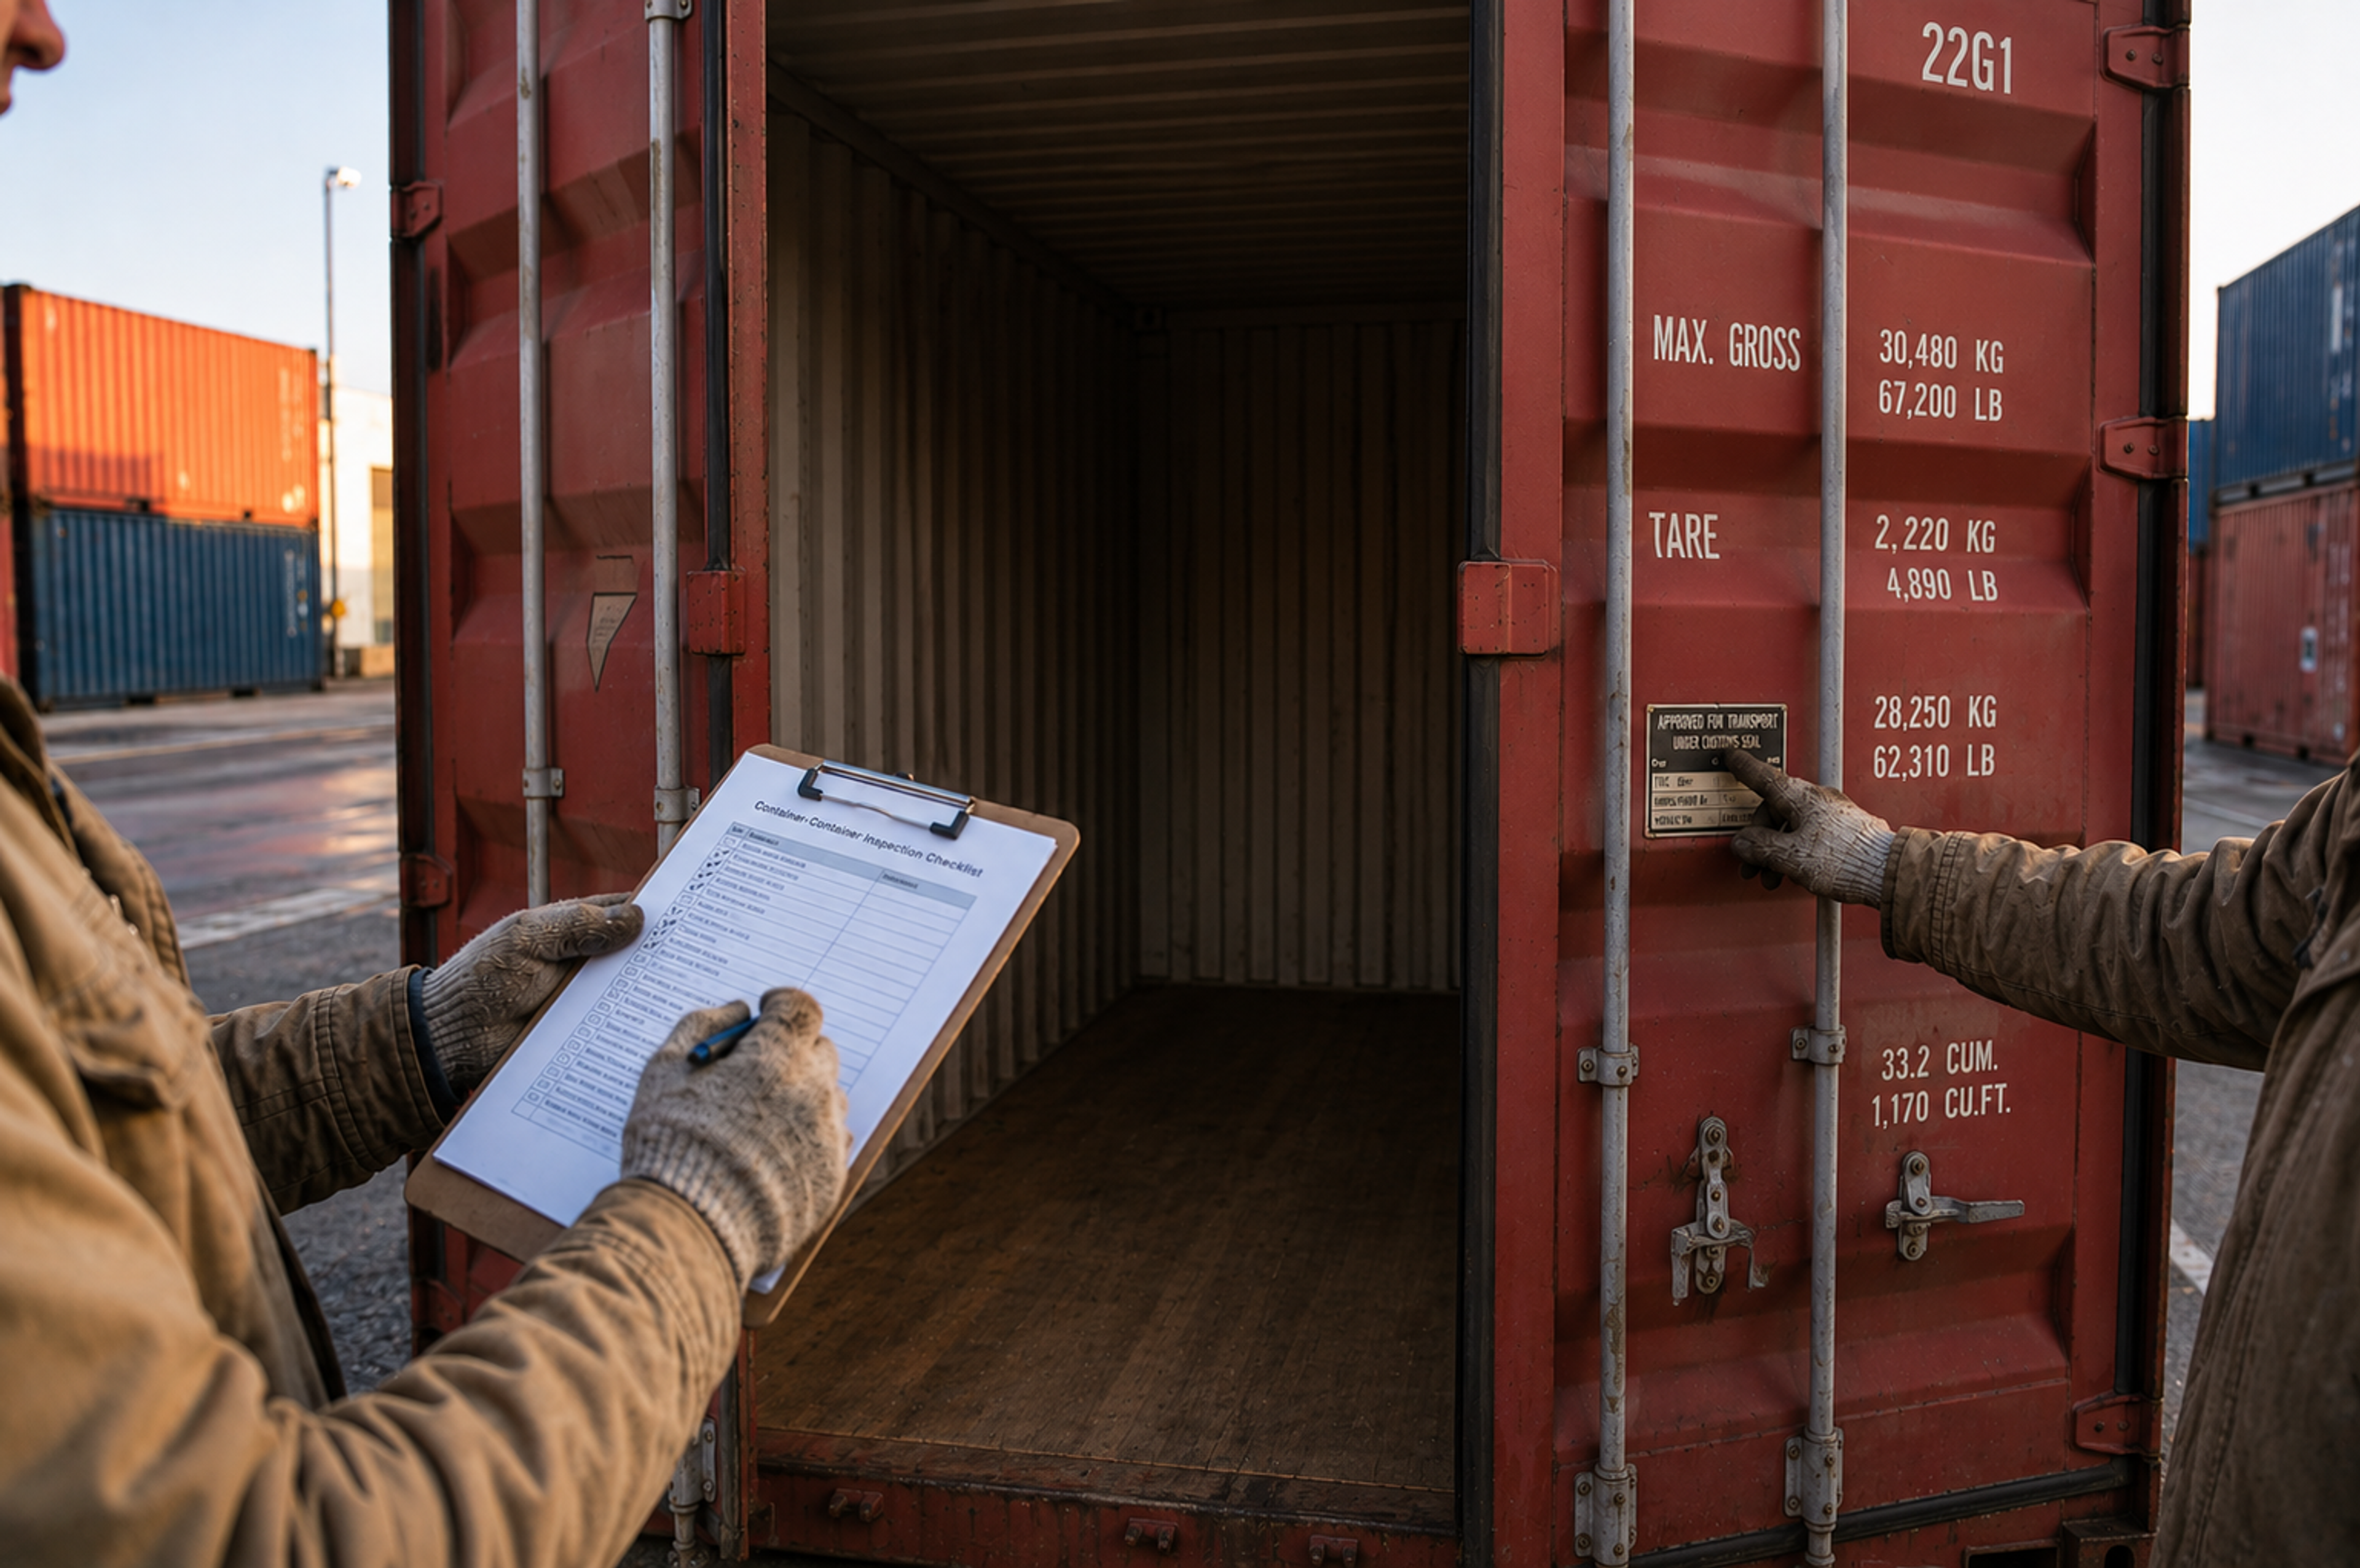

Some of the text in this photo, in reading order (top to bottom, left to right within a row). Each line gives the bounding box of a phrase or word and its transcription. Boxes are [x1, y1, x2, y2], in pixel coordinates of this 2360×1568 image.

[1922, 22, 2012, 94] 22G1
[1654, 315, 1800, 371] MAX. GROSS
[1879, 329, 2004, 374] 30,480 KG
[1879, 380, 2002, 421] 67,200 LB
[1649, 512, 1720, 559] TARE
[1875, 515, 1996, 554] 2,220 KG
[1887, 568, 1997, 602] 4,890 LB
[1874, 695, 1996, 731] 28,250 KG
[1874, 744, 1994, 782] 62,310 LB
[863, 833, 923, 859] Inspection
[926, 852, 983, 877] Checklist
[1882, 1040, 1998, 1080] 33.2 CUM.
[1872, 1083, 2011, 1130] 1,170 CU.FT.
